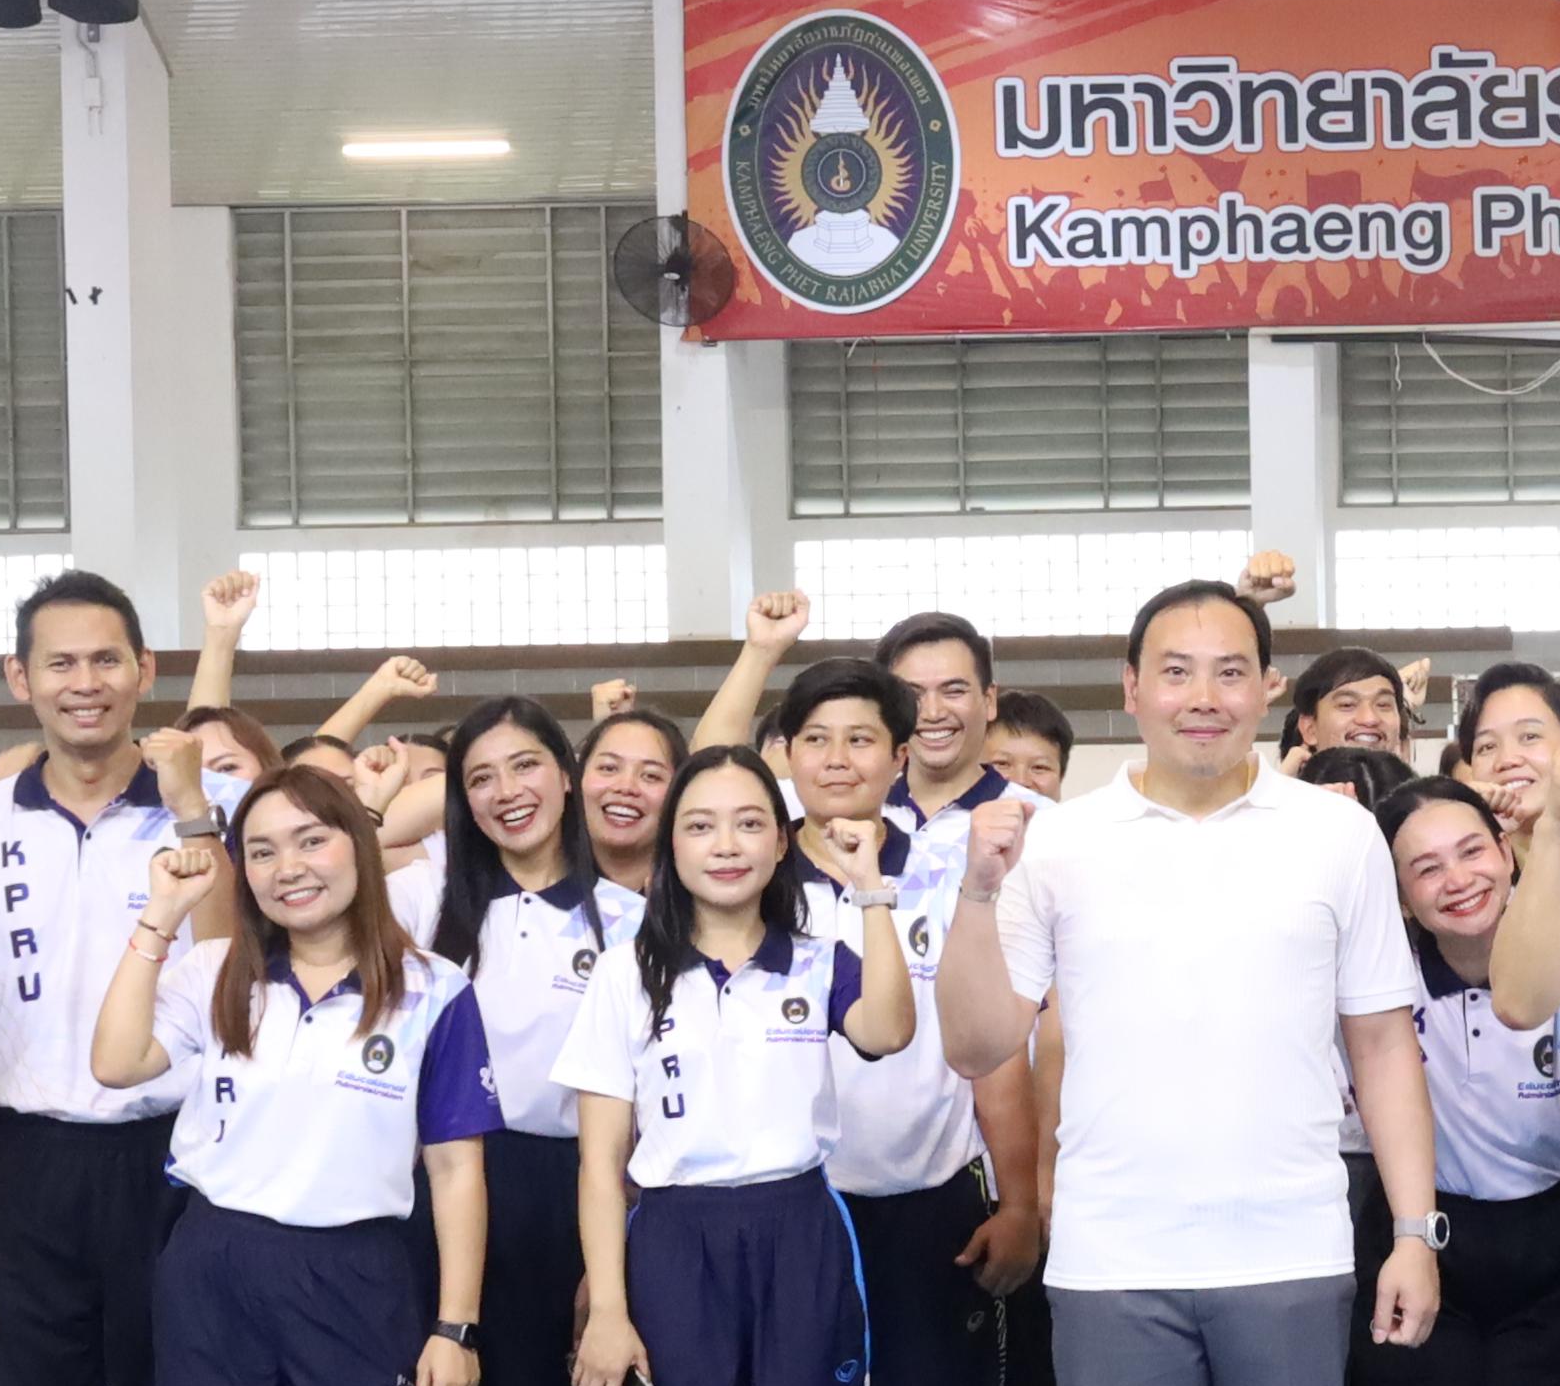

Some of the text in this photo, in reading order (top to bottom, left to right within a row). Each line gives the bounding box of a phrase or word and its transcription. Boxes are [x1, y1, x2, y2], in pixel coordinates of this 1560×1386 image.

[736, 161, 783, 265] KAMPHAENG
[779, 262, 819, 296] PHET
[825, 261, 909, 304] RAJABHAT
[910, 161, 946, 260] UNIVERSITY
[1014, 199, 1443, 271] Kamphaeng
[1, 840, 41, 1002] KPRU
